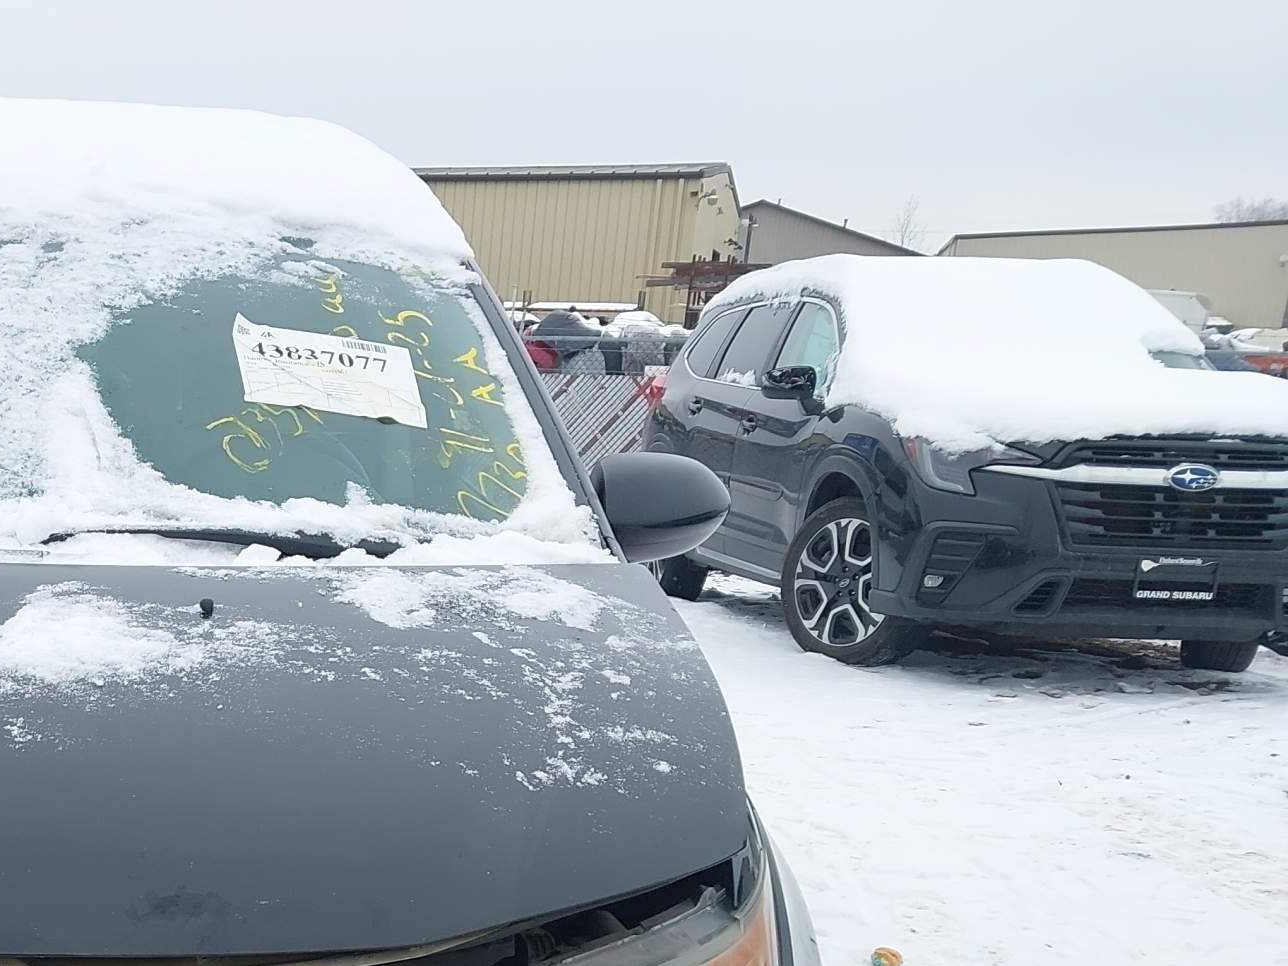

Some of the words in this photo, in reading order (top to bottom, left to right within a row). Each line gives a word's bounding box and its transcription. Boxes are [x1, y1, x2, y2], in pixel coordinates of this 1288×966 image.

[250, 341, 388, 374] 43837077
[1136, 590, 1171, 599] GRAND
[1171, 591, 1214, 600] SUBARU
